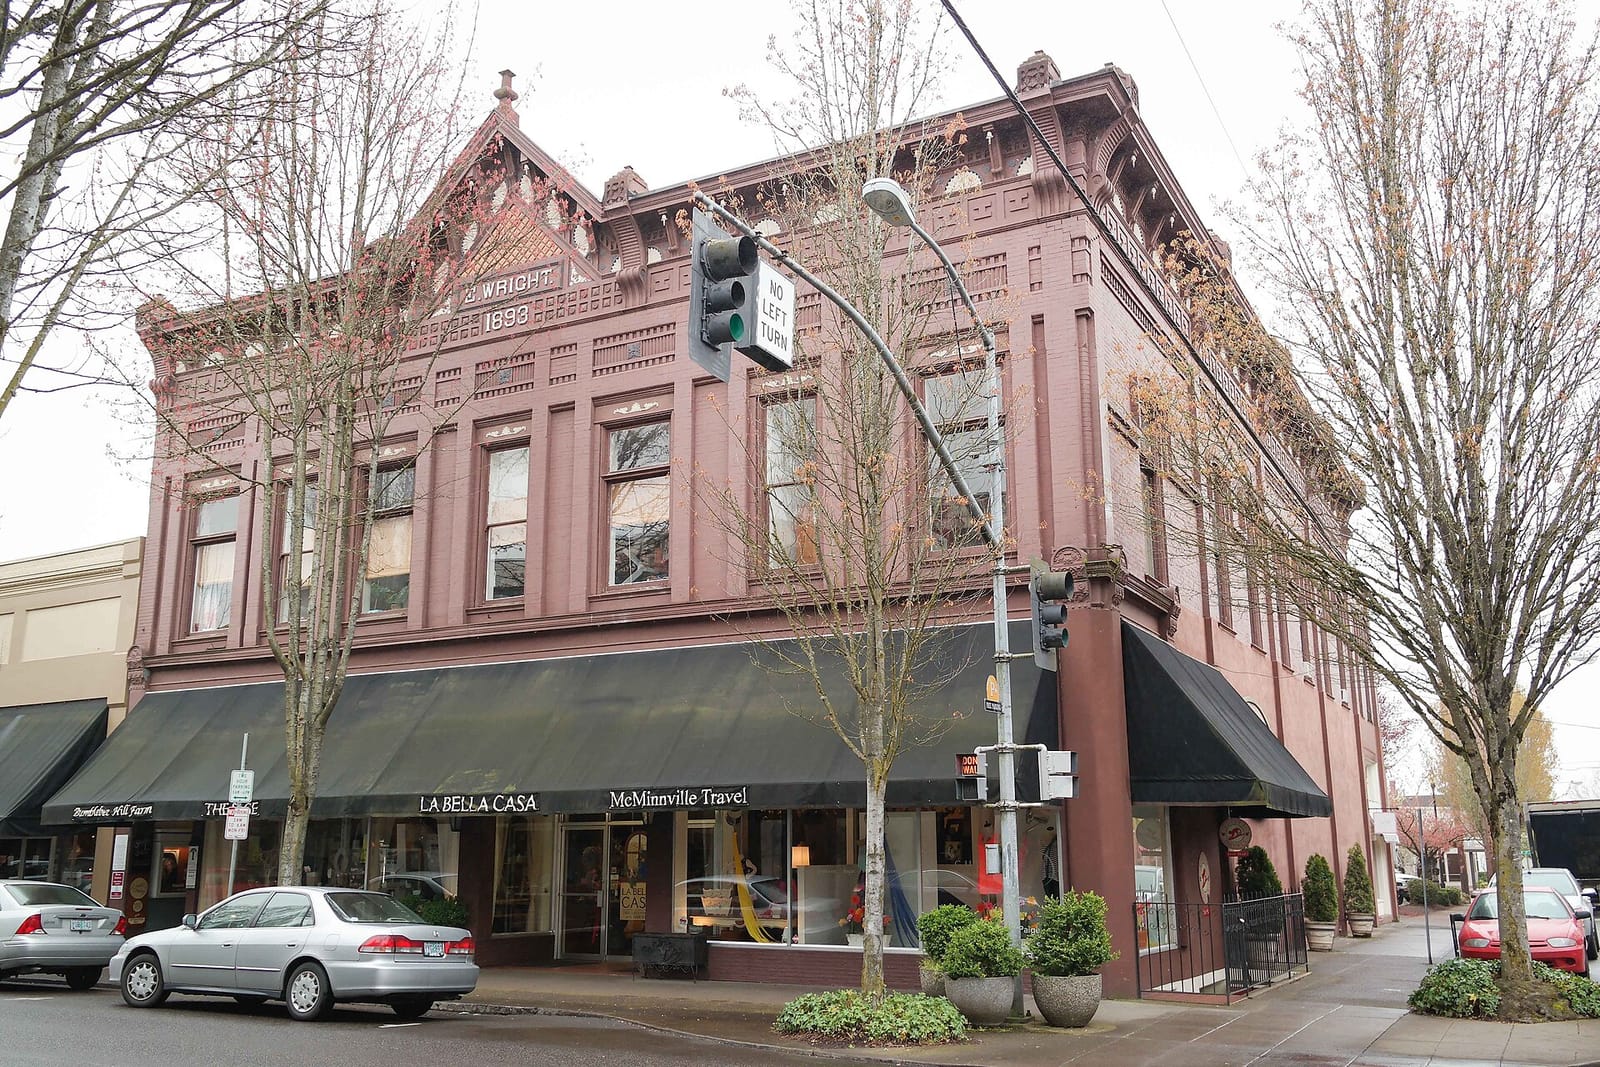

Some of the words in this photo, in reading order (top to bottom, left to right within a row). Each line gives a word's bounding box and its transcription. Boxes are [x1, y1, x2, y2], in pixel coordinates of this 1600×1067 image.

[770, 280, 783, 300] NO
[485, 305, 528, 332] 1893
[763, 298, 787, 327] LEFT
[761, 321, 788, 351] TURN
[962, 756, 978, 765] DON
[962, 765, 978, 774] WAL
[420, 796, 439, 812] LA
[442, 795, 488, 812] BELLA
[492, 794, 538, 812] CASA
[610, 789, 697, 808] McMinnville
[701, 787, 747, 805] Travel
[73, 805, 110, 817] Bumblebee
[111, 804, 129, 816] Hill
[129, 805, 153, 817] Farm
[205, 802, 229, 816] THE
[622, 896, 646, 909] CAS
